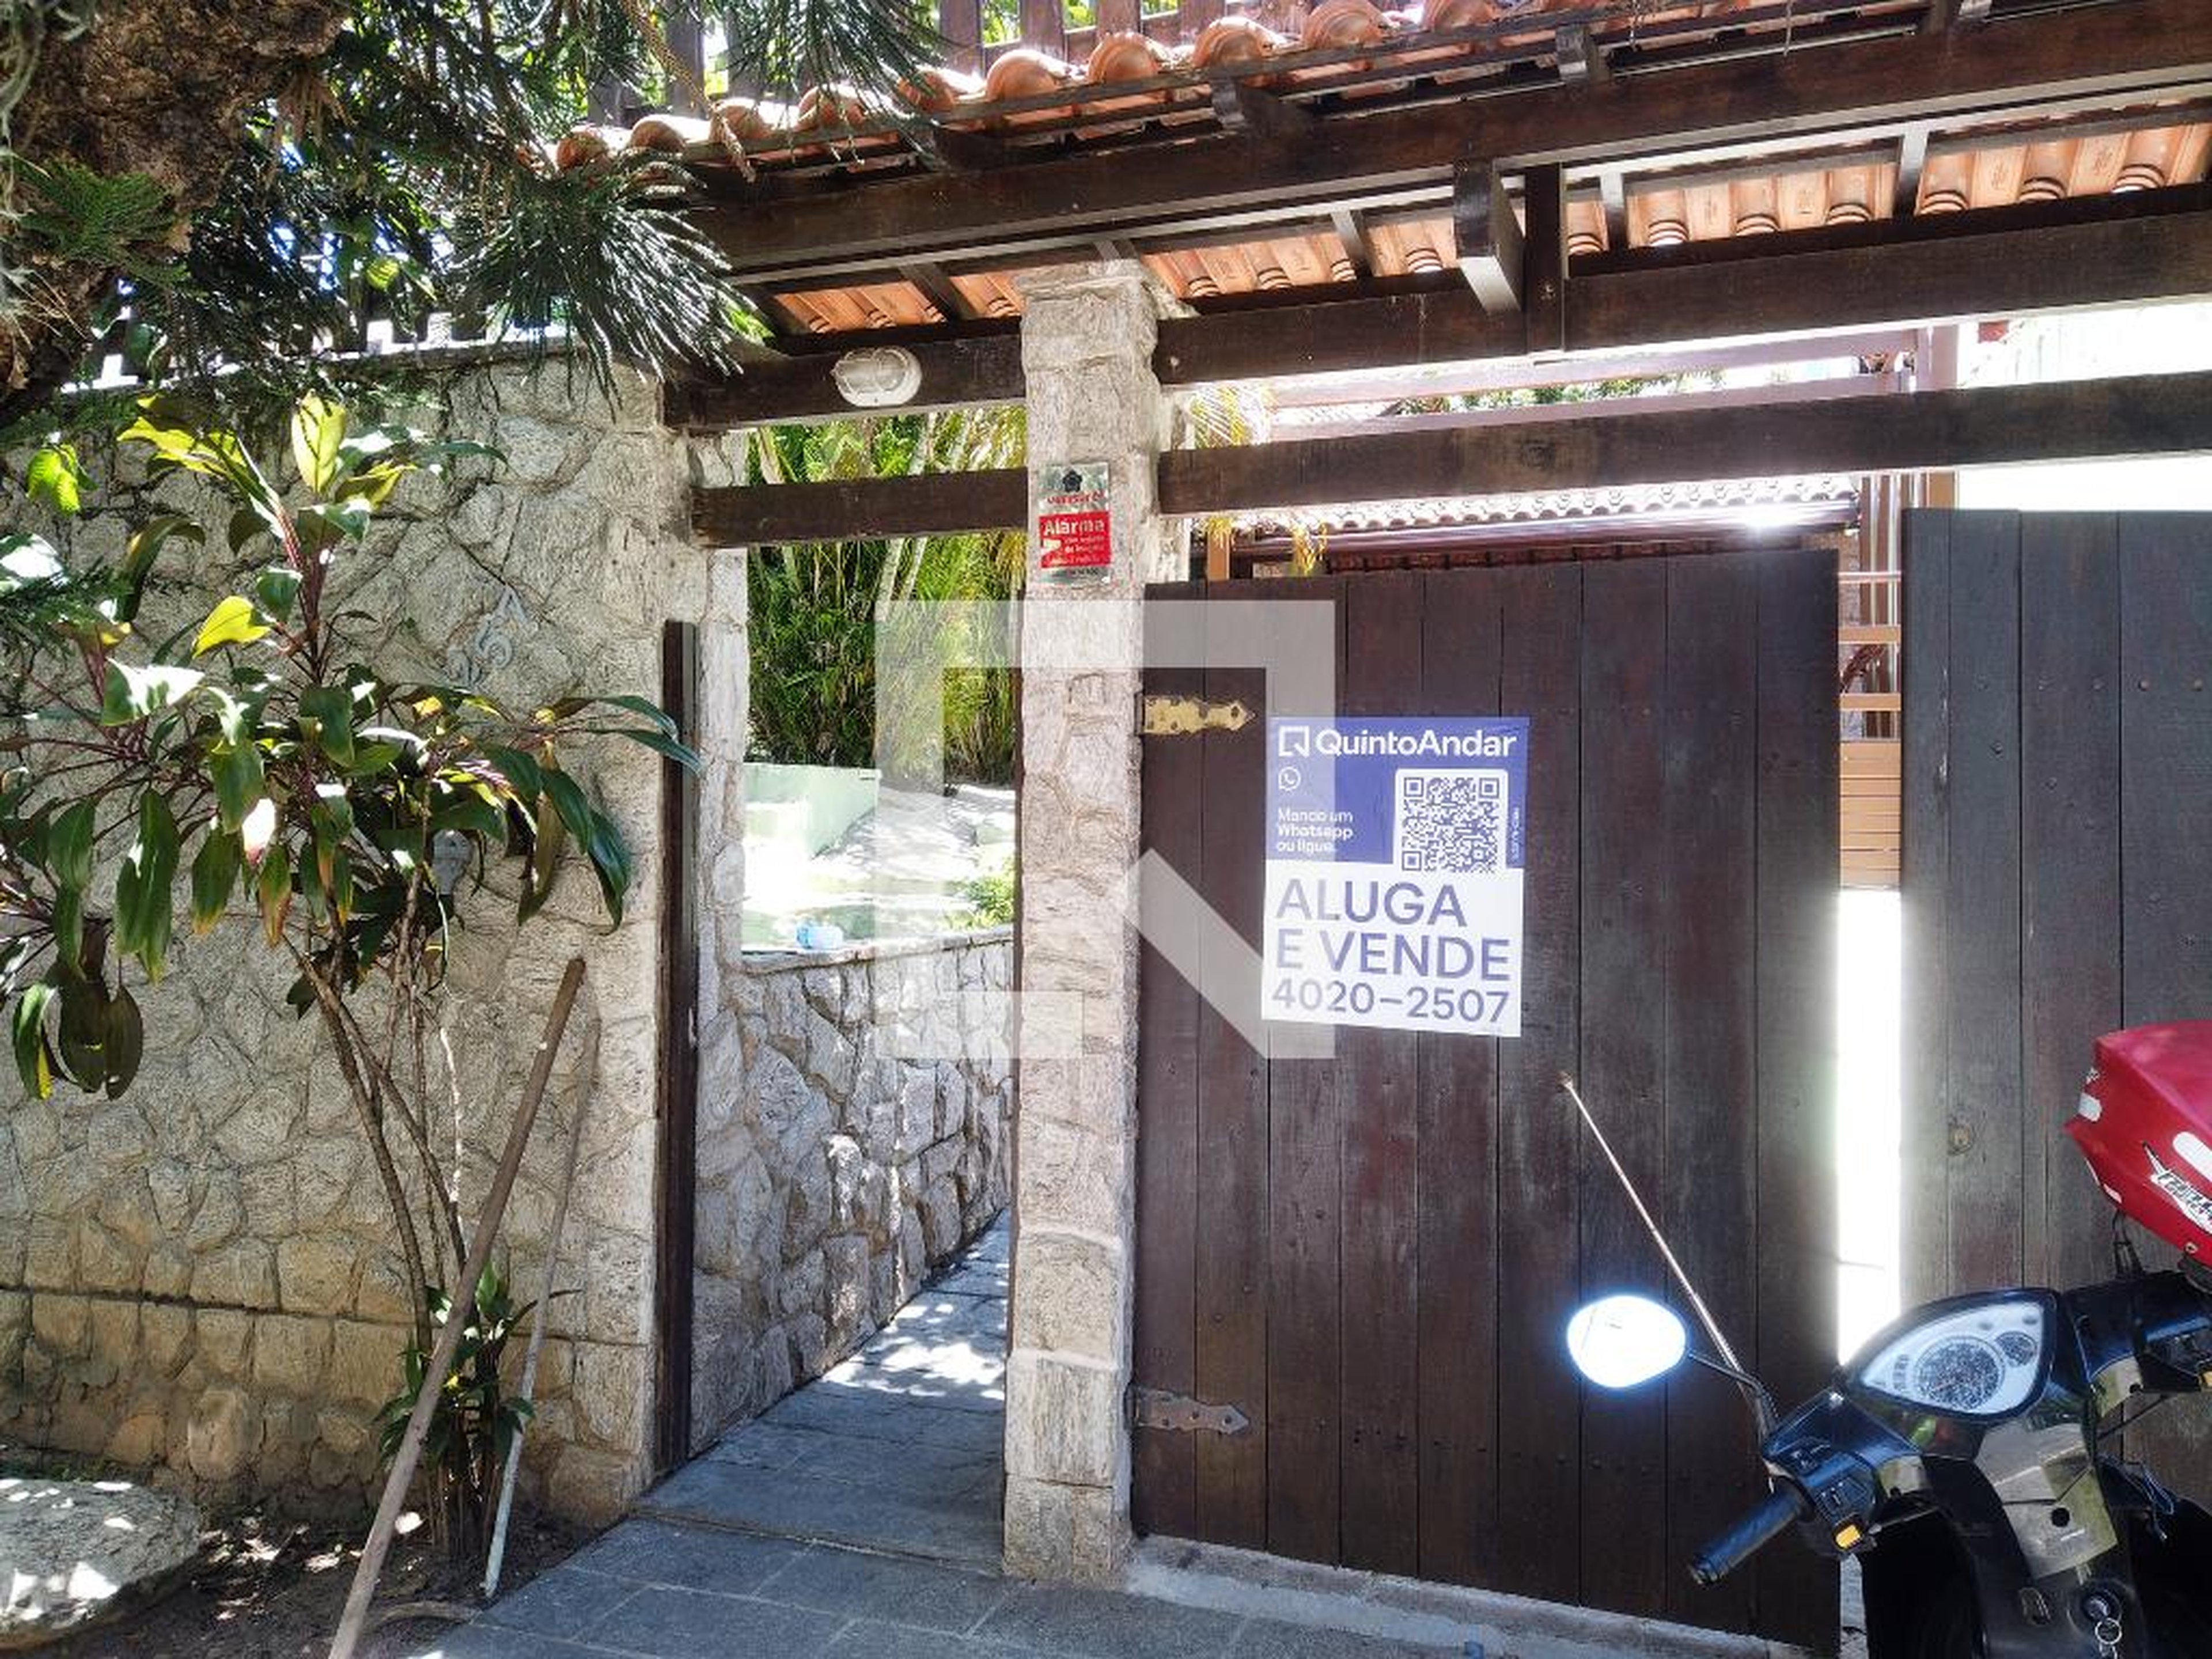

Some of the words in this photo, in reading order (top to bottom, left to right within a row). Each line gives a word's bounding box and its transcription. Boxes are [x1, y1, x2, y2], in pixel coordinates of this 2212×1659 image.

[1316, 730, 1516, 757] QuintoAndar
[1277, 840, 1296, 852] ou
[1276, 878, 1468, 927] ALUGA
[1277, 929, 1304, 969] E
[1319, 931, 1510, 981] VENDE
[1271, 978, 1510, 1023] 4020-2507
